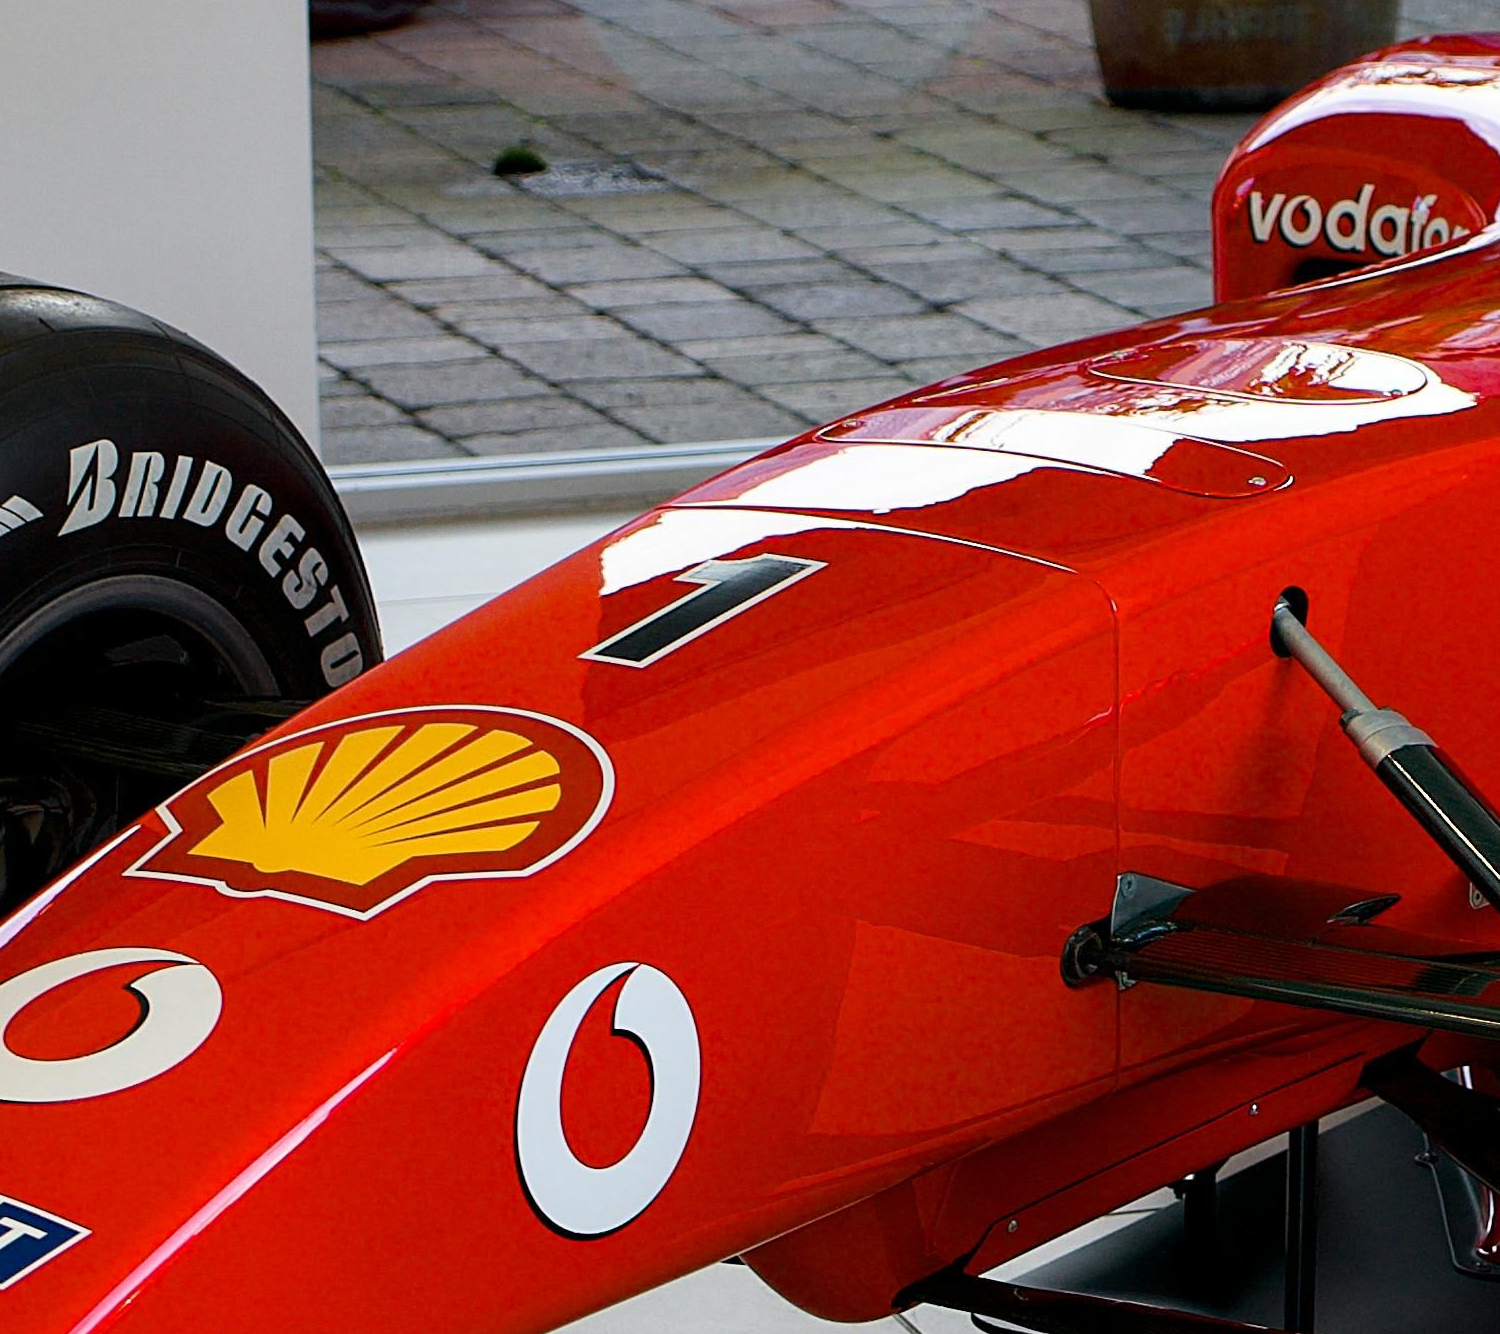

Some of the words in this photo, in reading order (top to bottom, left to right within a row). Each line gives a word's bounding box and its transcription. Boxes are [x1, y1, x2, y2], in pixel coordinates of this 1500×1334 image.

[1250, 183, 1471, 255] vodafo
[58, 438, 364, 688] BRIDGESTO
[578, 553, 828, 668] 1
